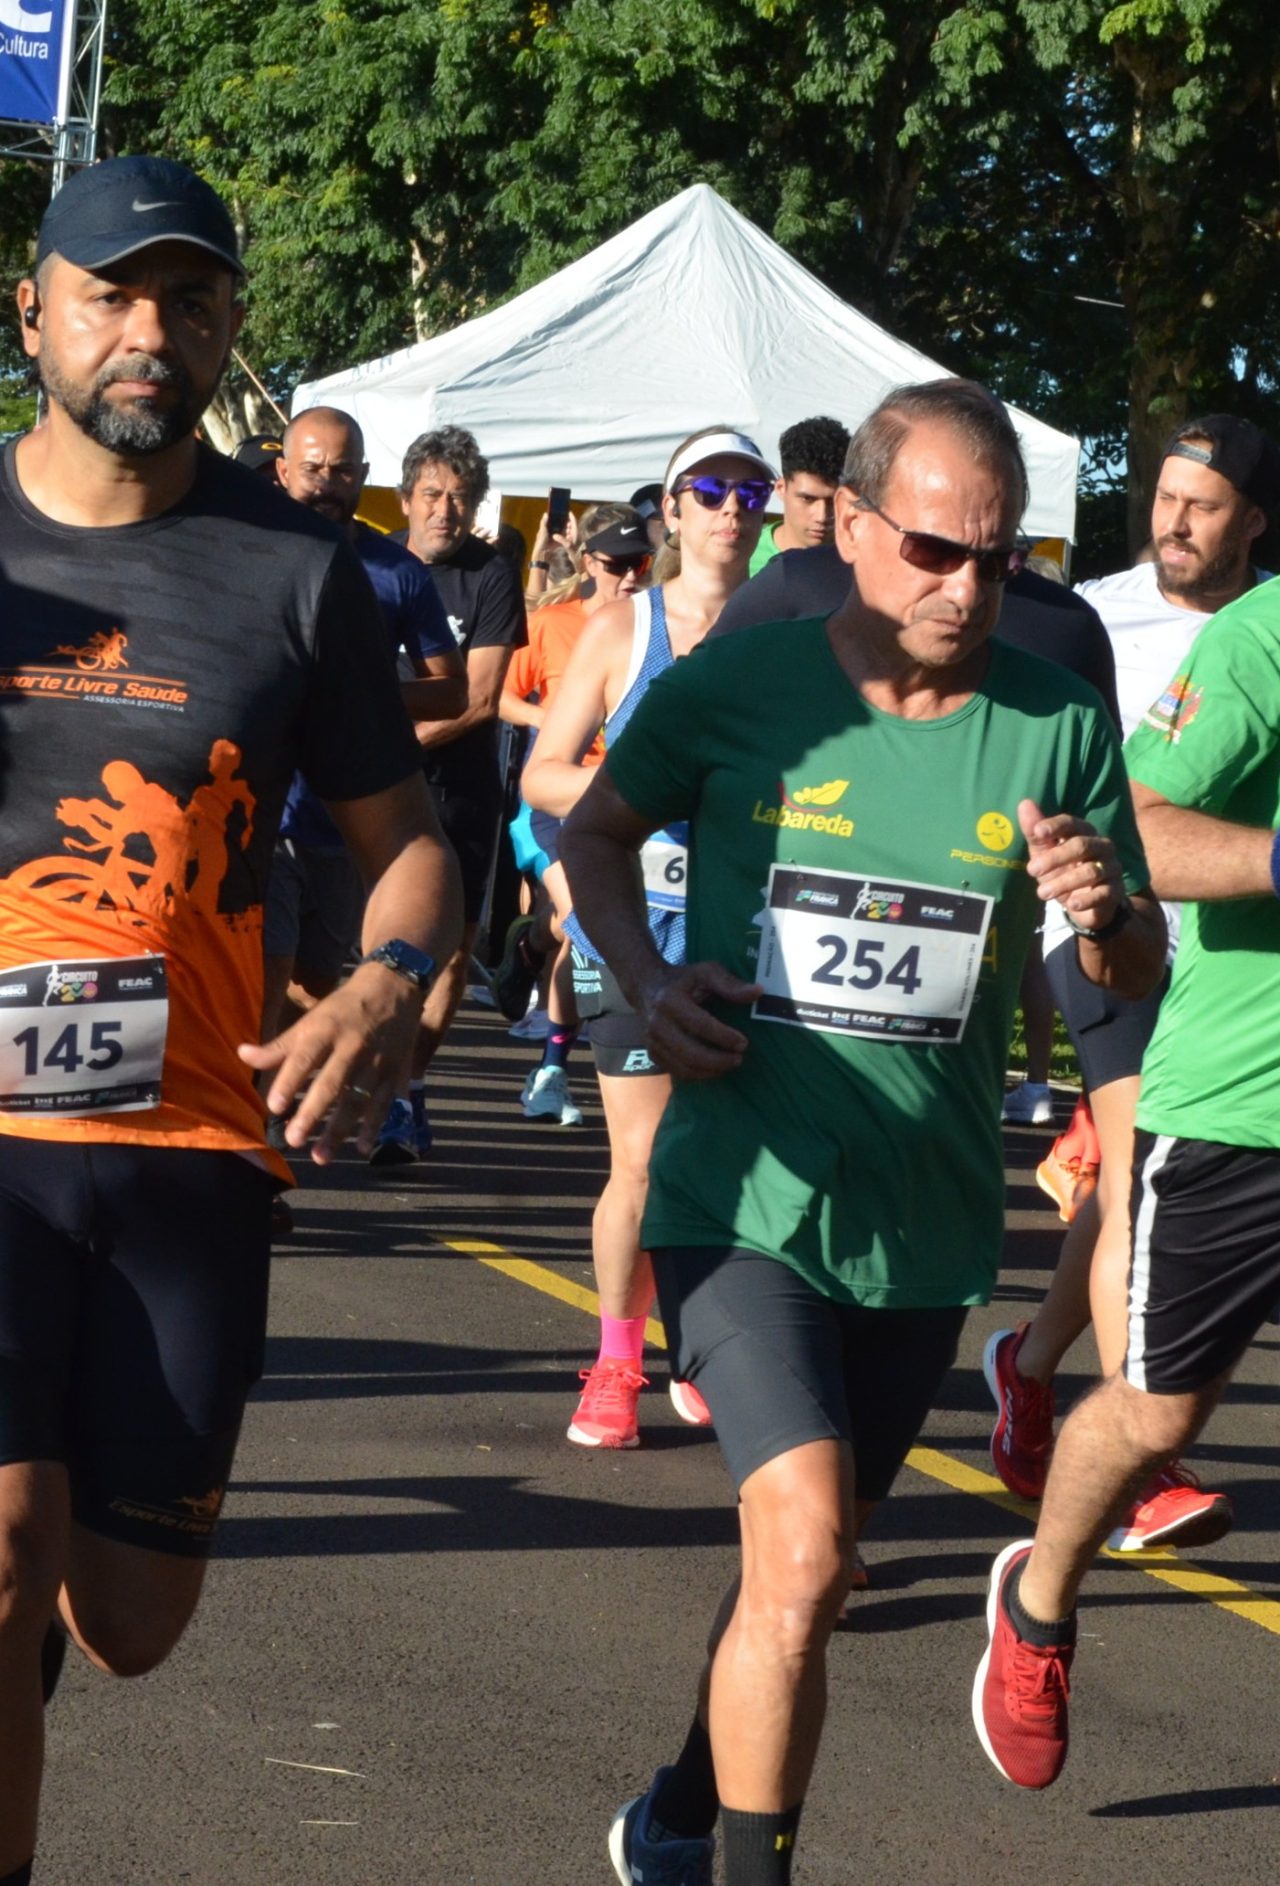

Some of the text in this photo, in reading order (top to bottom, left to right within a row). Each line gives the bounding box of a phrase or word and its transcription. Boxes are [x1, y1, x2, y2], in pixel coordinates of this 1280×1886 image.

[0, 675, 62, 690] sporte
[64, 676, 119, 695] Livre
[82, 694, 185, 712] ASSESSORIA ESPORTIVA
[752, 800, 855, 838] Labareda
[920, 906, 955, 918] FEAC
[811, 934, 922, 995] 254
[118, 977, 153, 988] FEAC
[852, 1014, 886, 1024] FEAC
[13, 1021, 124, 1076] 145
[56, 1093, 92, 1104] FEAC
